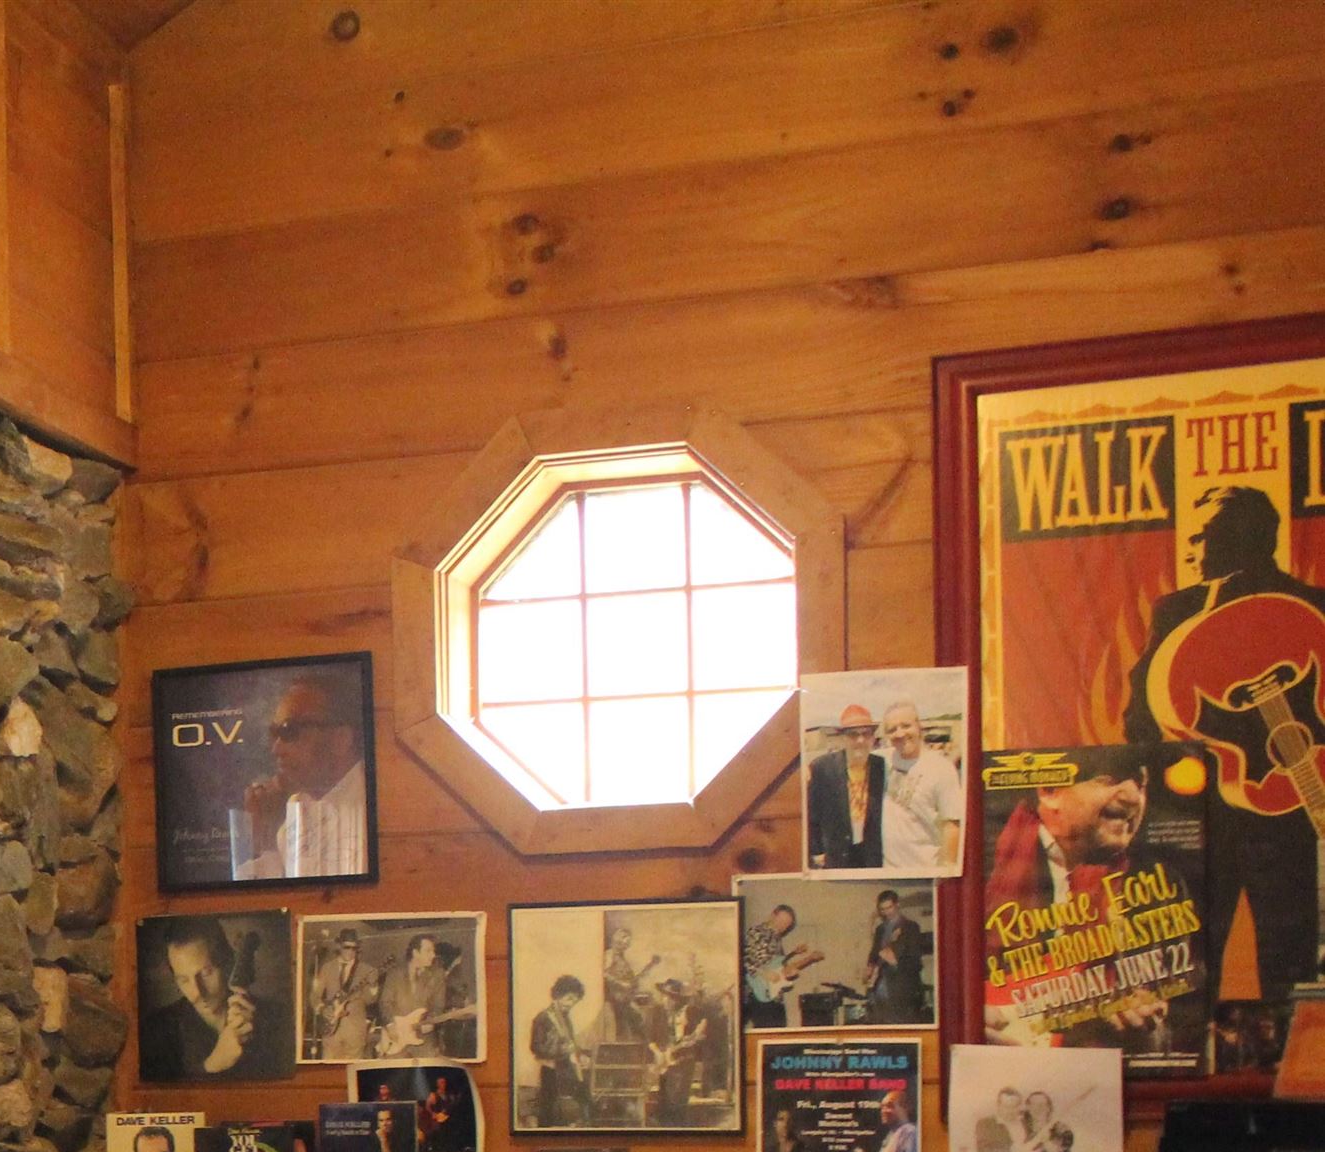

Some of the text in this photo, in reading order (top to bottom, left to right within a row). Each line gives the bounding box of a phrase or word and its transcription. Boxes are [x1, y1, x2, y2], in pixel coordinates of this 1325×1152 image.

[1006, 426, 1169, 532] WALK
[1186, 411, 1279, 478] THE
[173, 720, 243, 747] O.V.
[986, 863, 1177, 947] Ronnie Earl
[987, 899, 1201, 987] & THE BROADCASTERS
[1115, 949, 1168, 990] JUNE
[1167, 942, 1194, 975] 22
[771, 1056, 908, 1069] JOHNNY RAWLS
[775, 1079, 811, 1090] DAVE
[815, 1079, 865, 1090] KELLER
[116, 1116, 195, 1126] DAVE KELLER
